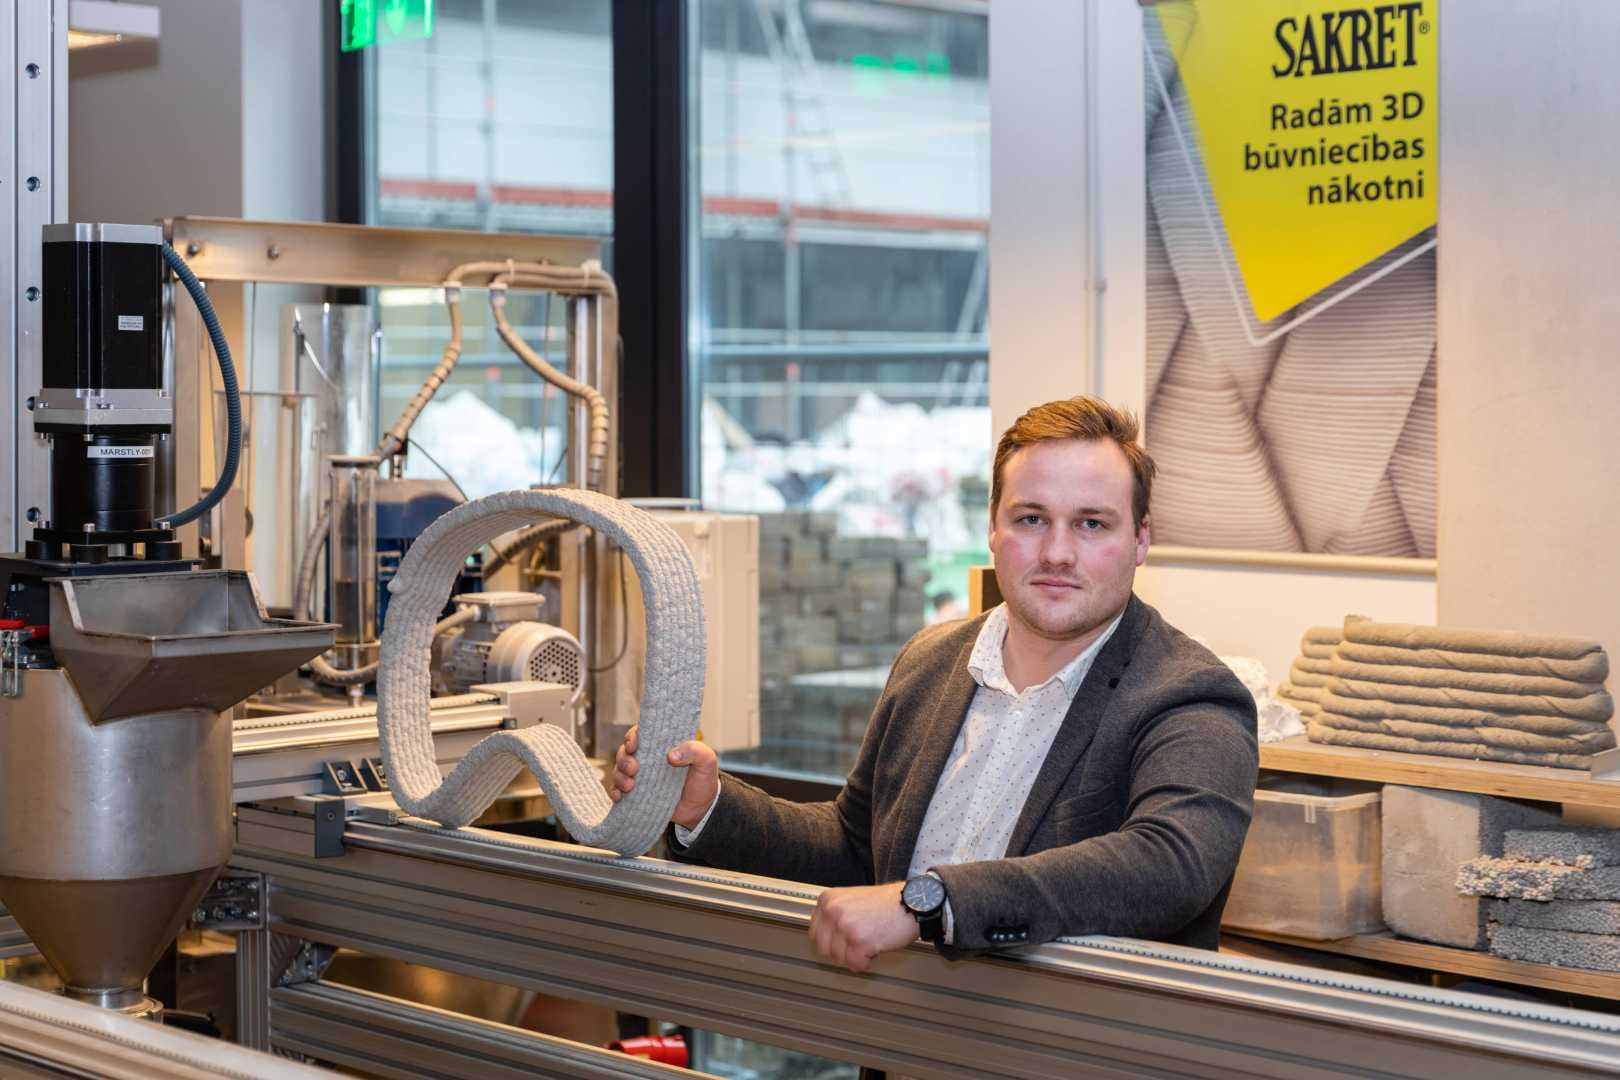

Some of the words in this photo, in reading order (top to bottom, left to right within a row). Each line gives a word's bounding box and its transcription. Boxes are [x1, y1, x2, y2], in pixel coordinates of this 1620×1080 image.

[1271, 98, 1372, 130] Radām
[1382, 92, 1424, 121] 3D
[1245, 134, 1424, 171] būvniecības
[1308, 171, 1424, 205] nākotni
